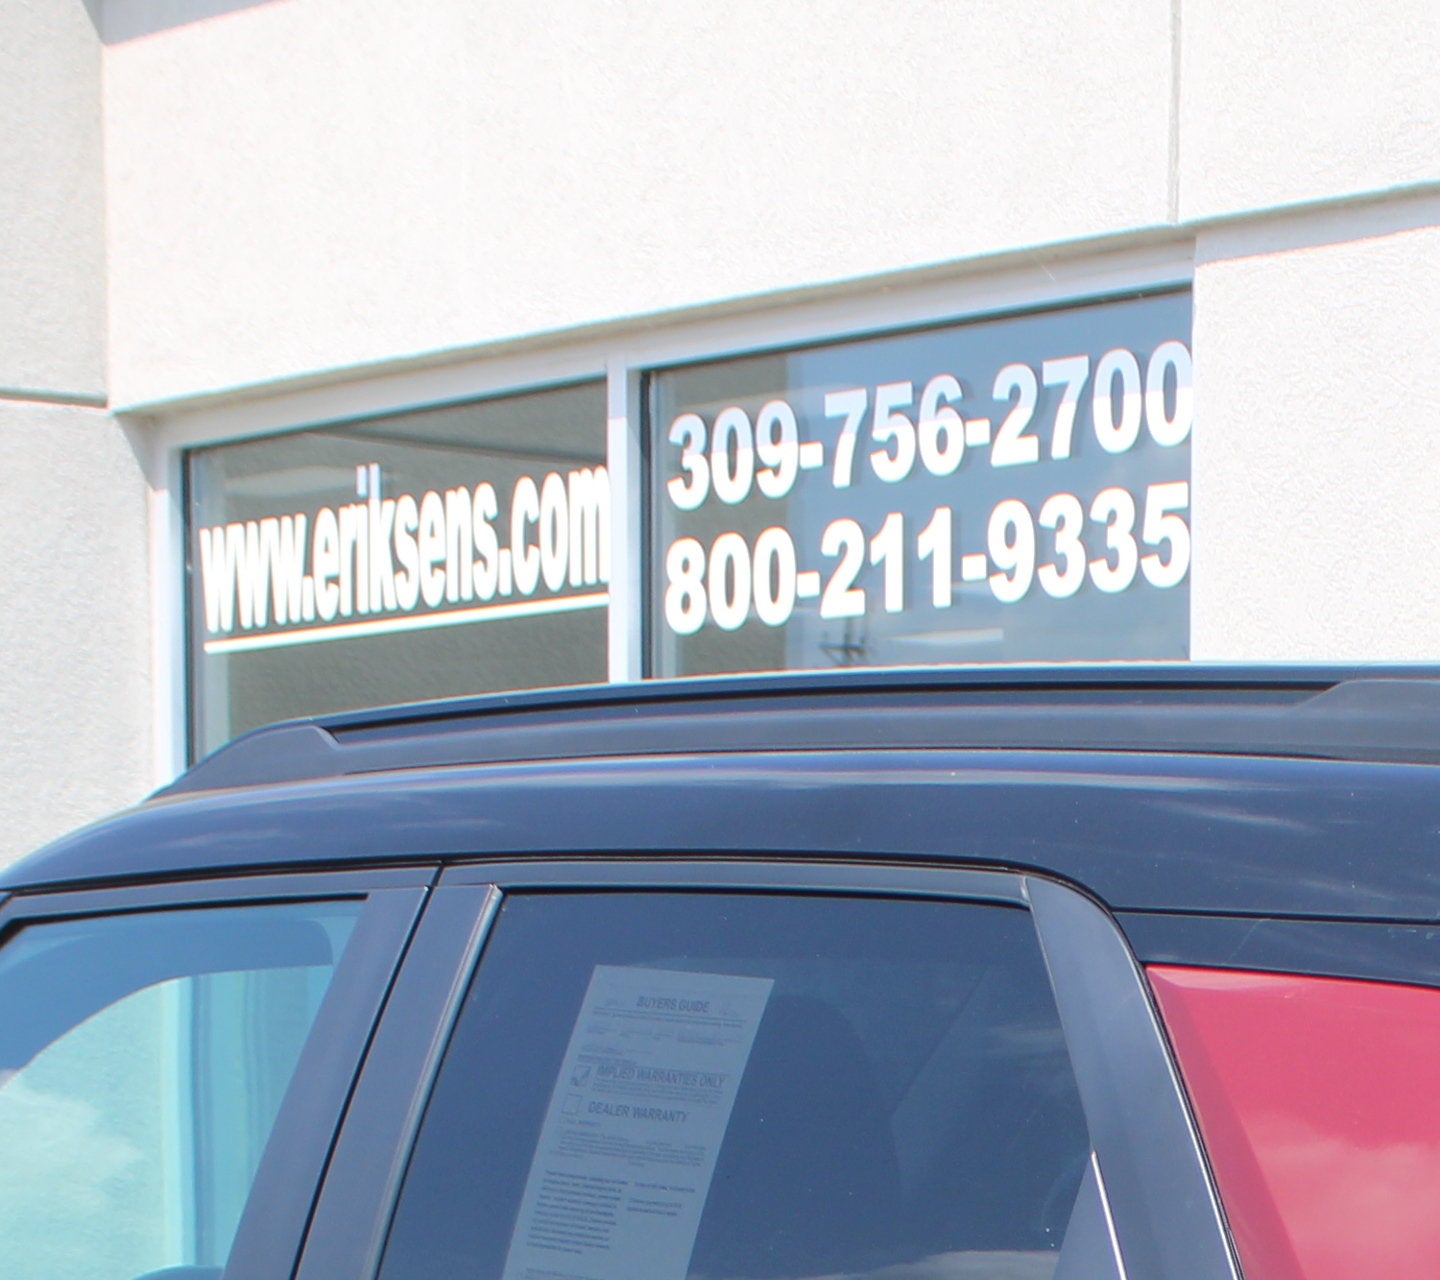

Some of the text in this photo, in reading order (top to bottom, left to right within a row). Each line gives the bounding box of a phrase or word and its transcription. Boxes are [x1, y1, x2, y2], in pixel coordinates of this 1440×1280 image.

[666, 341, 1193, 511] 309-756-2700
[199, 462, 609, 634] www.eriksens.com
[664, 481, 1191, 635] 800-211-9335
[636, 996, 710, 1013] BUYERS GUIDE
[588, 1101, 689, 1122] DEALER WARRANTY
